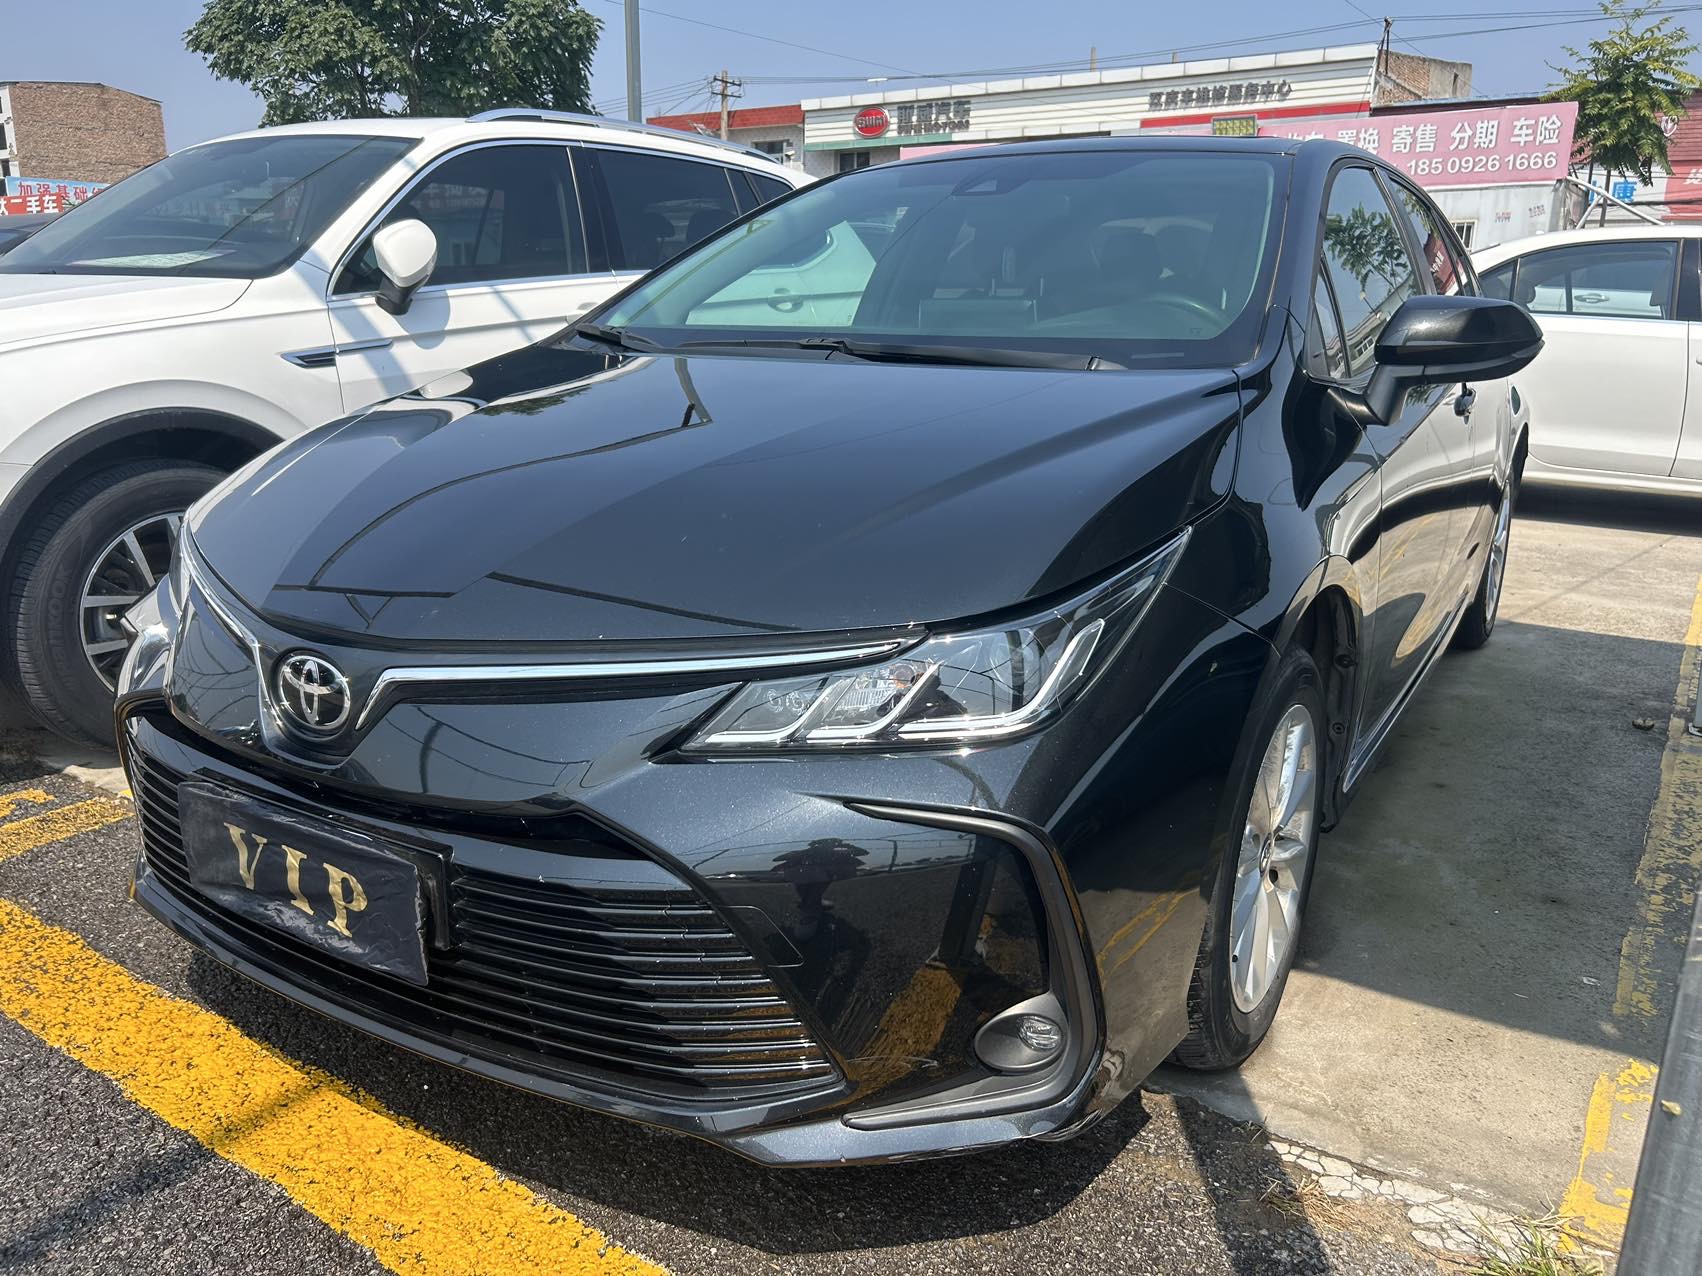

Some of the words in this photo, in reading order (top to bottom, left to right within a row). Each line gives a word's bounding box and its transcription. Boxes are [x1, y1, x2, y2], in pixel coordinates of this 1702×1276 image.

[1392, 123, 1438, 153] 寄售
[1449, 120, 1498, 150] 分期
[1511, 114, 1562, 146] 车险
[224, 822, 368, 937] VIP
